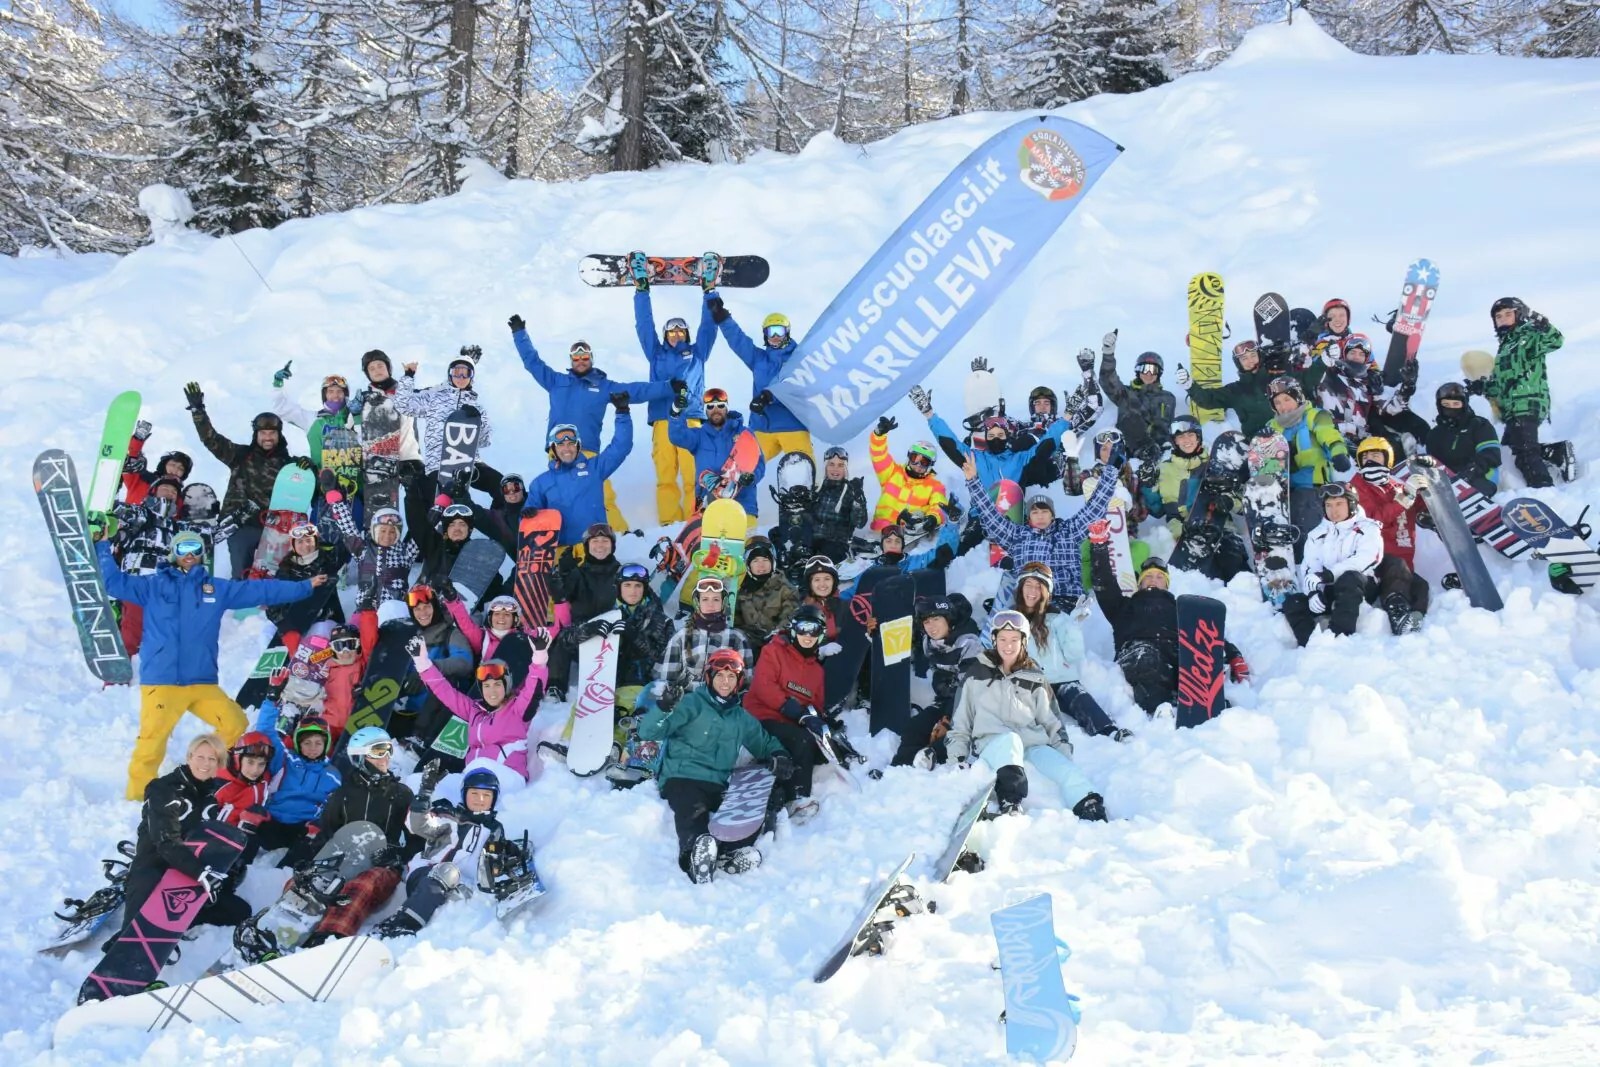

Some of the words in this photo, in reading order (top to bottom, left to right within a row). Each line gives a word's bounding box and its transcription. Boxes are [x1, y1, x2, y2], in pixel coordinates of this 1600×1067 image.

[788, 156, 1009, 387] www.scuolasci.it
[807, 225, 1017, 429] MARILLEVA
[41, 456, 121, 677] ROSSIGNOL
